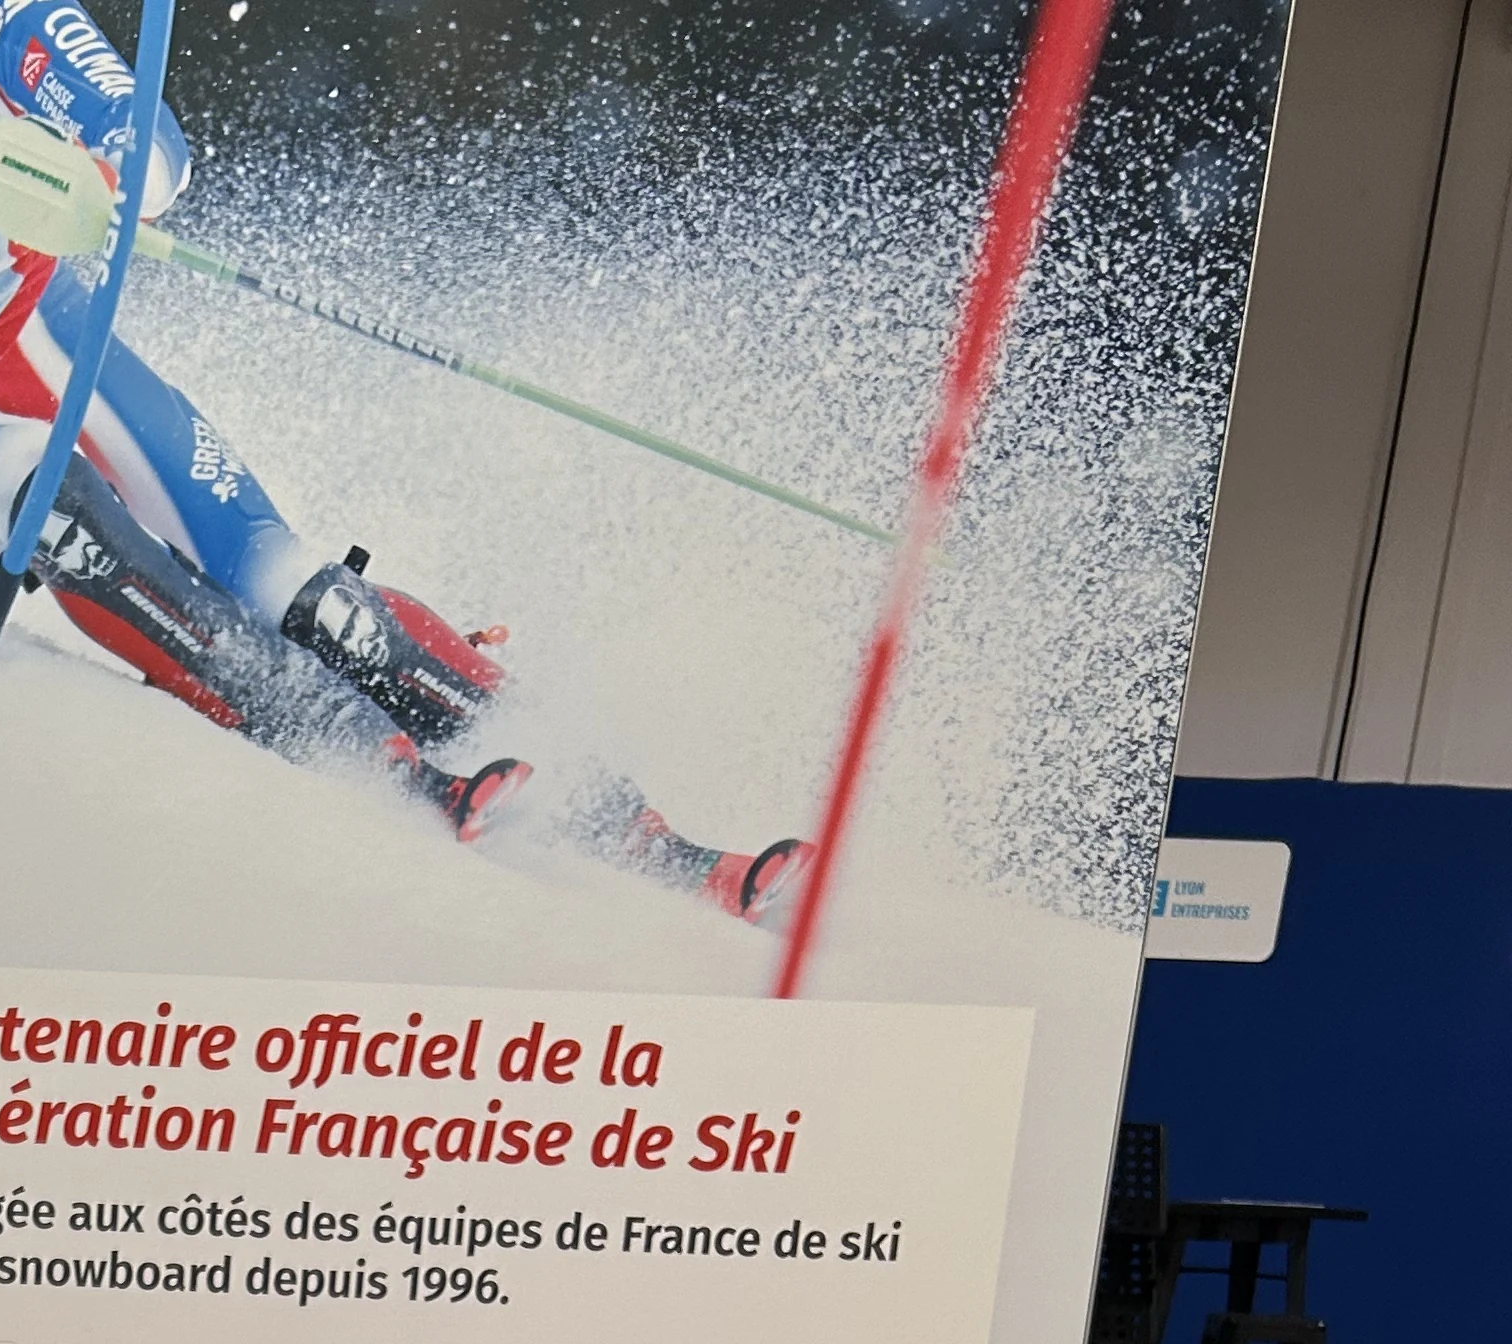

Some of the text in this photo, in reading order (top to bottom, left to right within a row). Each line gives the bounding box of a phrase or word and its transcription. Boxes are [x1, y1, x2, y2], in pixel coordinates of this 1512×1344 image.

[1170, 903, 1251, 922] ENTREPRISES
[1174, 880, 1206, 896] LYON
[257, 1012, 481, 1087] officiel
[500, 1022, 582, 1084] de
[601, 1026, 662, 1087] la
[258, 1099, 573, 1178] Française
[591, 1109, 674, 1169] de
[691, 1111, 801, 1173] Ski
[69, 1203, 145, 1233] aux
[158, 1194, 271, 1239] côtés
[285, 1202, 359, 1242] des
[373, 1202, 542, 1257] équipes
[556, 1212, 608, 1252] de
[622, 1217, 760, 1257] France
[774, 1220, 827, 1260] de
[839, 1222, 902, 1262] ski
[246, 1257, 388, 1307] depuis
[402, 1266, 509, 1305] 1996.
